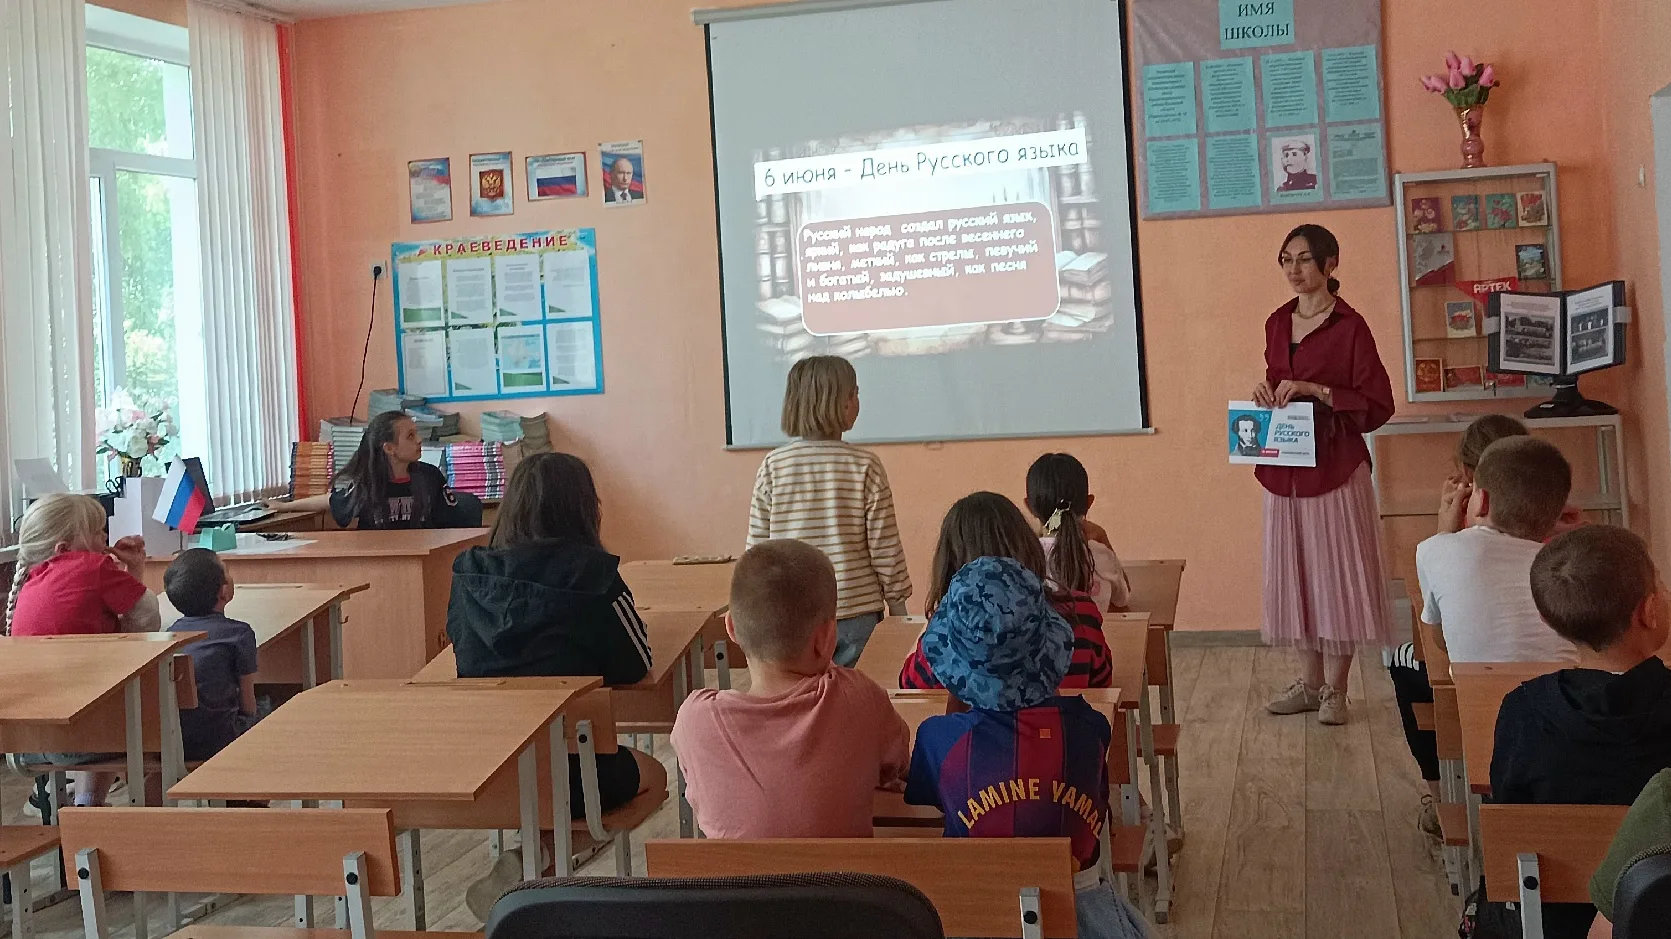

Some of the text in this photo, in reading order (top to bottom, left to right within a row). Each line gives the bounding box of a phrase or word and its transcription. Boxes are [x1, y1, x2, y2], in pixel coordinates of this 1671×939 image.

[1237, 1, 1275, 17] ИМЯ
[1224, 23, 1290, 40] ШКОЛЫ
[764, 167, 776, 187] 6
[782, 167, 837, 185] июня
[860, 156, 910, 181] День
[916, 148, 1010, 176] Русского
[1016, 141, 1080, 162] языка
[803, 211, 1037, 245] Русский народ создал русский язык,
[433, 235, 569, 256] КРАЕВЕДЕНИЕ
[848, 242, 870, 254] как
[872, 238, 915, 255] радуга
[919, 234, 957, 248] после
[961, 228, 1025, 243] весеннего
[904, 252, 926, 265] как
[929, 248, 979, 265] стрелы,
[984, 239, 1039, 259] певучий
[806, 260, 1027, 288] и богатый, задушевный, как песня
[807, 285, 909, 303] над колыбелью.
[1473, 280, 1512, 294] АРТЕК
[1274, 430, 1311, 438] РУССКОГО
[1275, 422, 1295, 430] ДЕНЬ
[957, 778, 1103, 839] LAMINE YAMAL
